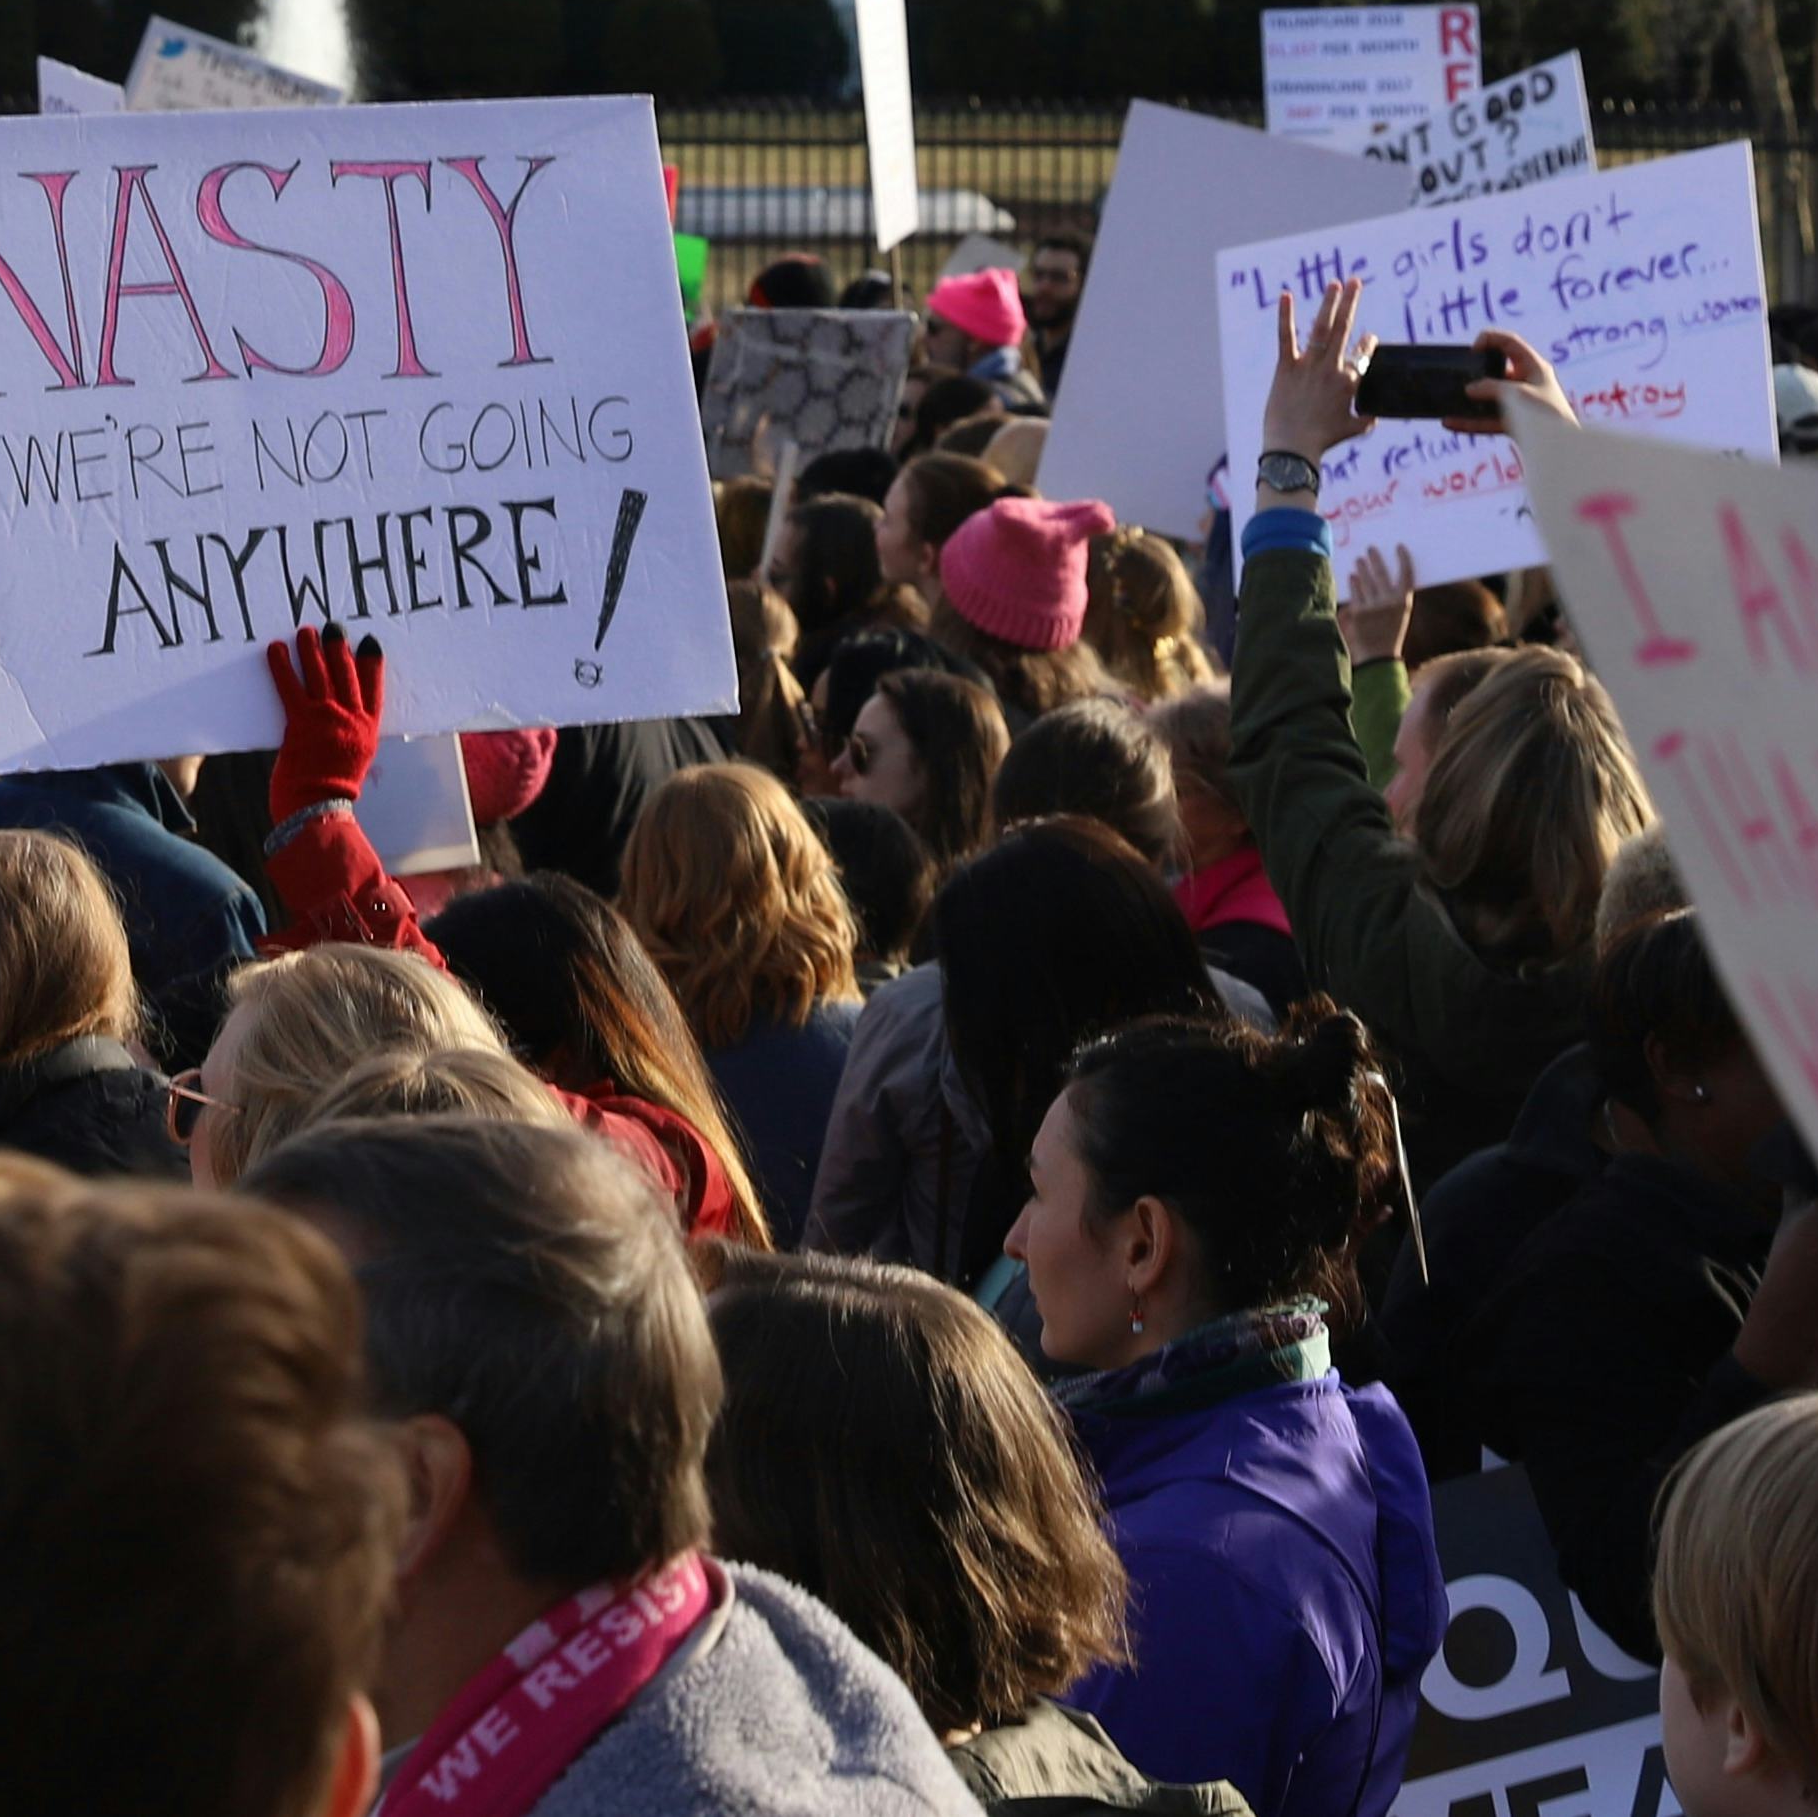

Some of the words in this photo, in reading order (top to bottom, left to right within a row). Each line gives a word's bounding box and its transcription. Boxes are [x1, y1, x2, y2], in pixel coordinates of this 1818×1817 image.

[1449, 68, 1557, 140] GOOD
[1392, 218, 1490, 305] girls
[1513, 191, 1634, 258] don't
[1402, 283, 1525, 342] little
[1550, 306, 1670, 372] strong
[1569, 379, 1687, 419] estroy
[249, 408, 389, 494] NOT
[417, 395, 636, 475] GOING
[1422, 440, 1525, 499] world
[1575, 489, 1700, 666] I
[418, 1704, 521, 1803] WE
